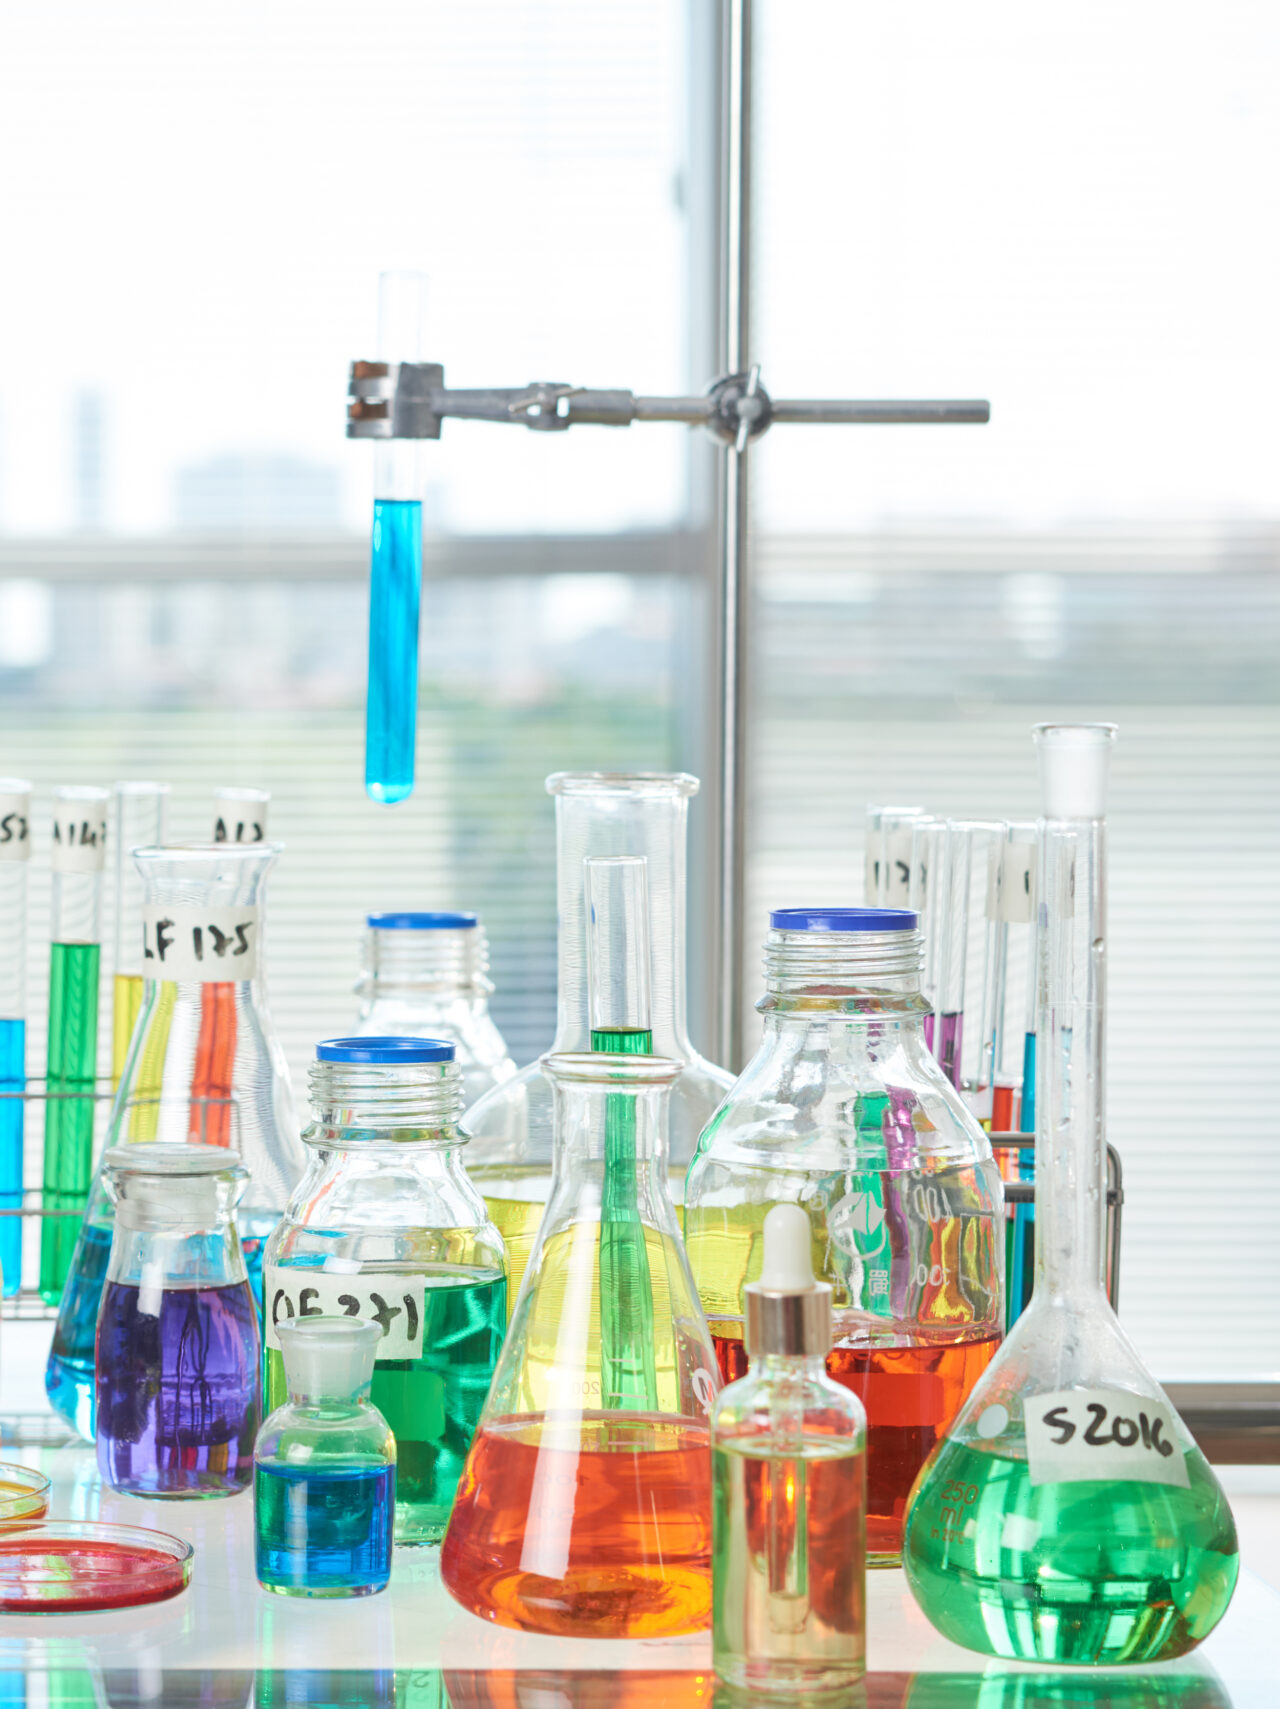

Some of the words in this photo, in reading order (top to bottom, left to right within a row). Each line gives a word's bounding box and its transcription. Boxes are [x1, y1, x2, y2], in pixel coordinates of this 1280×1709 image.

[1042, 1406, 1076, 1445] S
[1083, 1403, 1174, 1458] 2016
[940, 1479, 979, 1505] 250
[940, 1505, 964, 1526] ml
